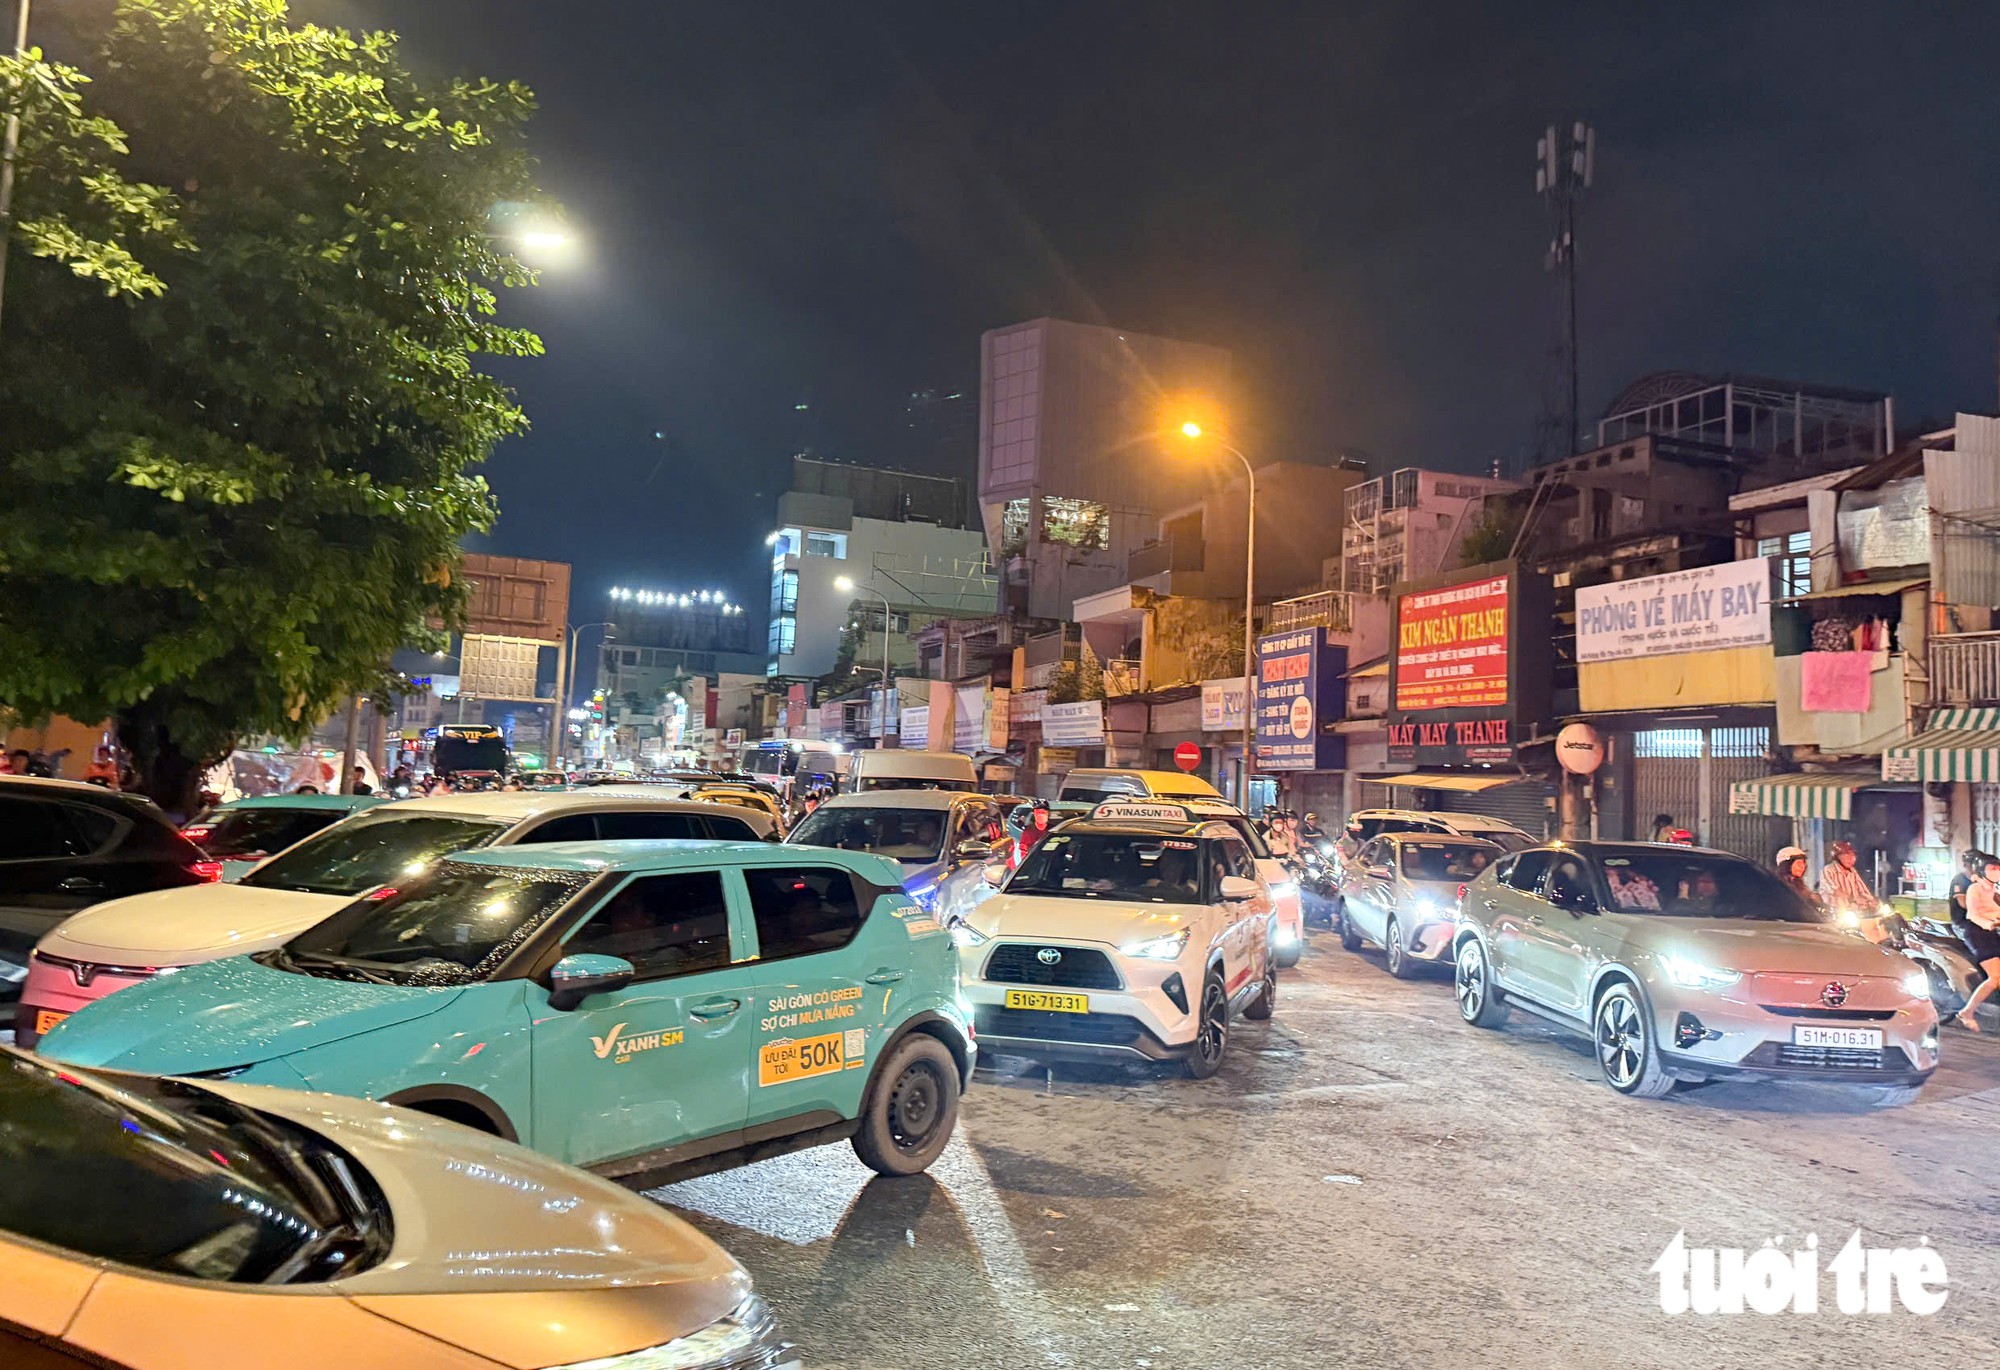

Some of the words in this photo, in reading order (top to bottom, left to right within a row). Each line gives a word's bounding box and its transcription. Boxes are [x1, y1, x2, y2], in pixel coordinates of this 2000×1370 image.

[1580, 596, 1637, 635] PHÒNG
[1643, 588, 1665, 627] VÉ
[1672, 583, 1714, 624] MÁY
[1721, 581, 1761, 618] BAY
[1400, 621, 1422, 649] KIM
[1423, 609, 1458, 646] NGÂN
[1460, 607, 1505, 641] THANH
[464, 731, 482, 740] VIP
[1389, 715, 1416, 746] MÁY
[1419, 722, 1450, 746] MAY
[1454, 719, 1508, 745] THANH
[768, 996, 787, 1012] SÀI
[789, 993, 812, 1009] GÒN
[831, 986, 862, 1002] GREEN
[1013, 993, 1080, 1010] 51G-713.31
[760, 1015, 778, 1032] SỢ
[779, 1013, 798, 1028] CHI
[800, 1008, 824, 1024] MƯA
[616, 1034, 660, 1055] XANH
[661, 1031, 684, 1046] SM
[1804, 1030, 1875, 1046] 51M-016.31
[800, 1040, 841, 1070] 50K
